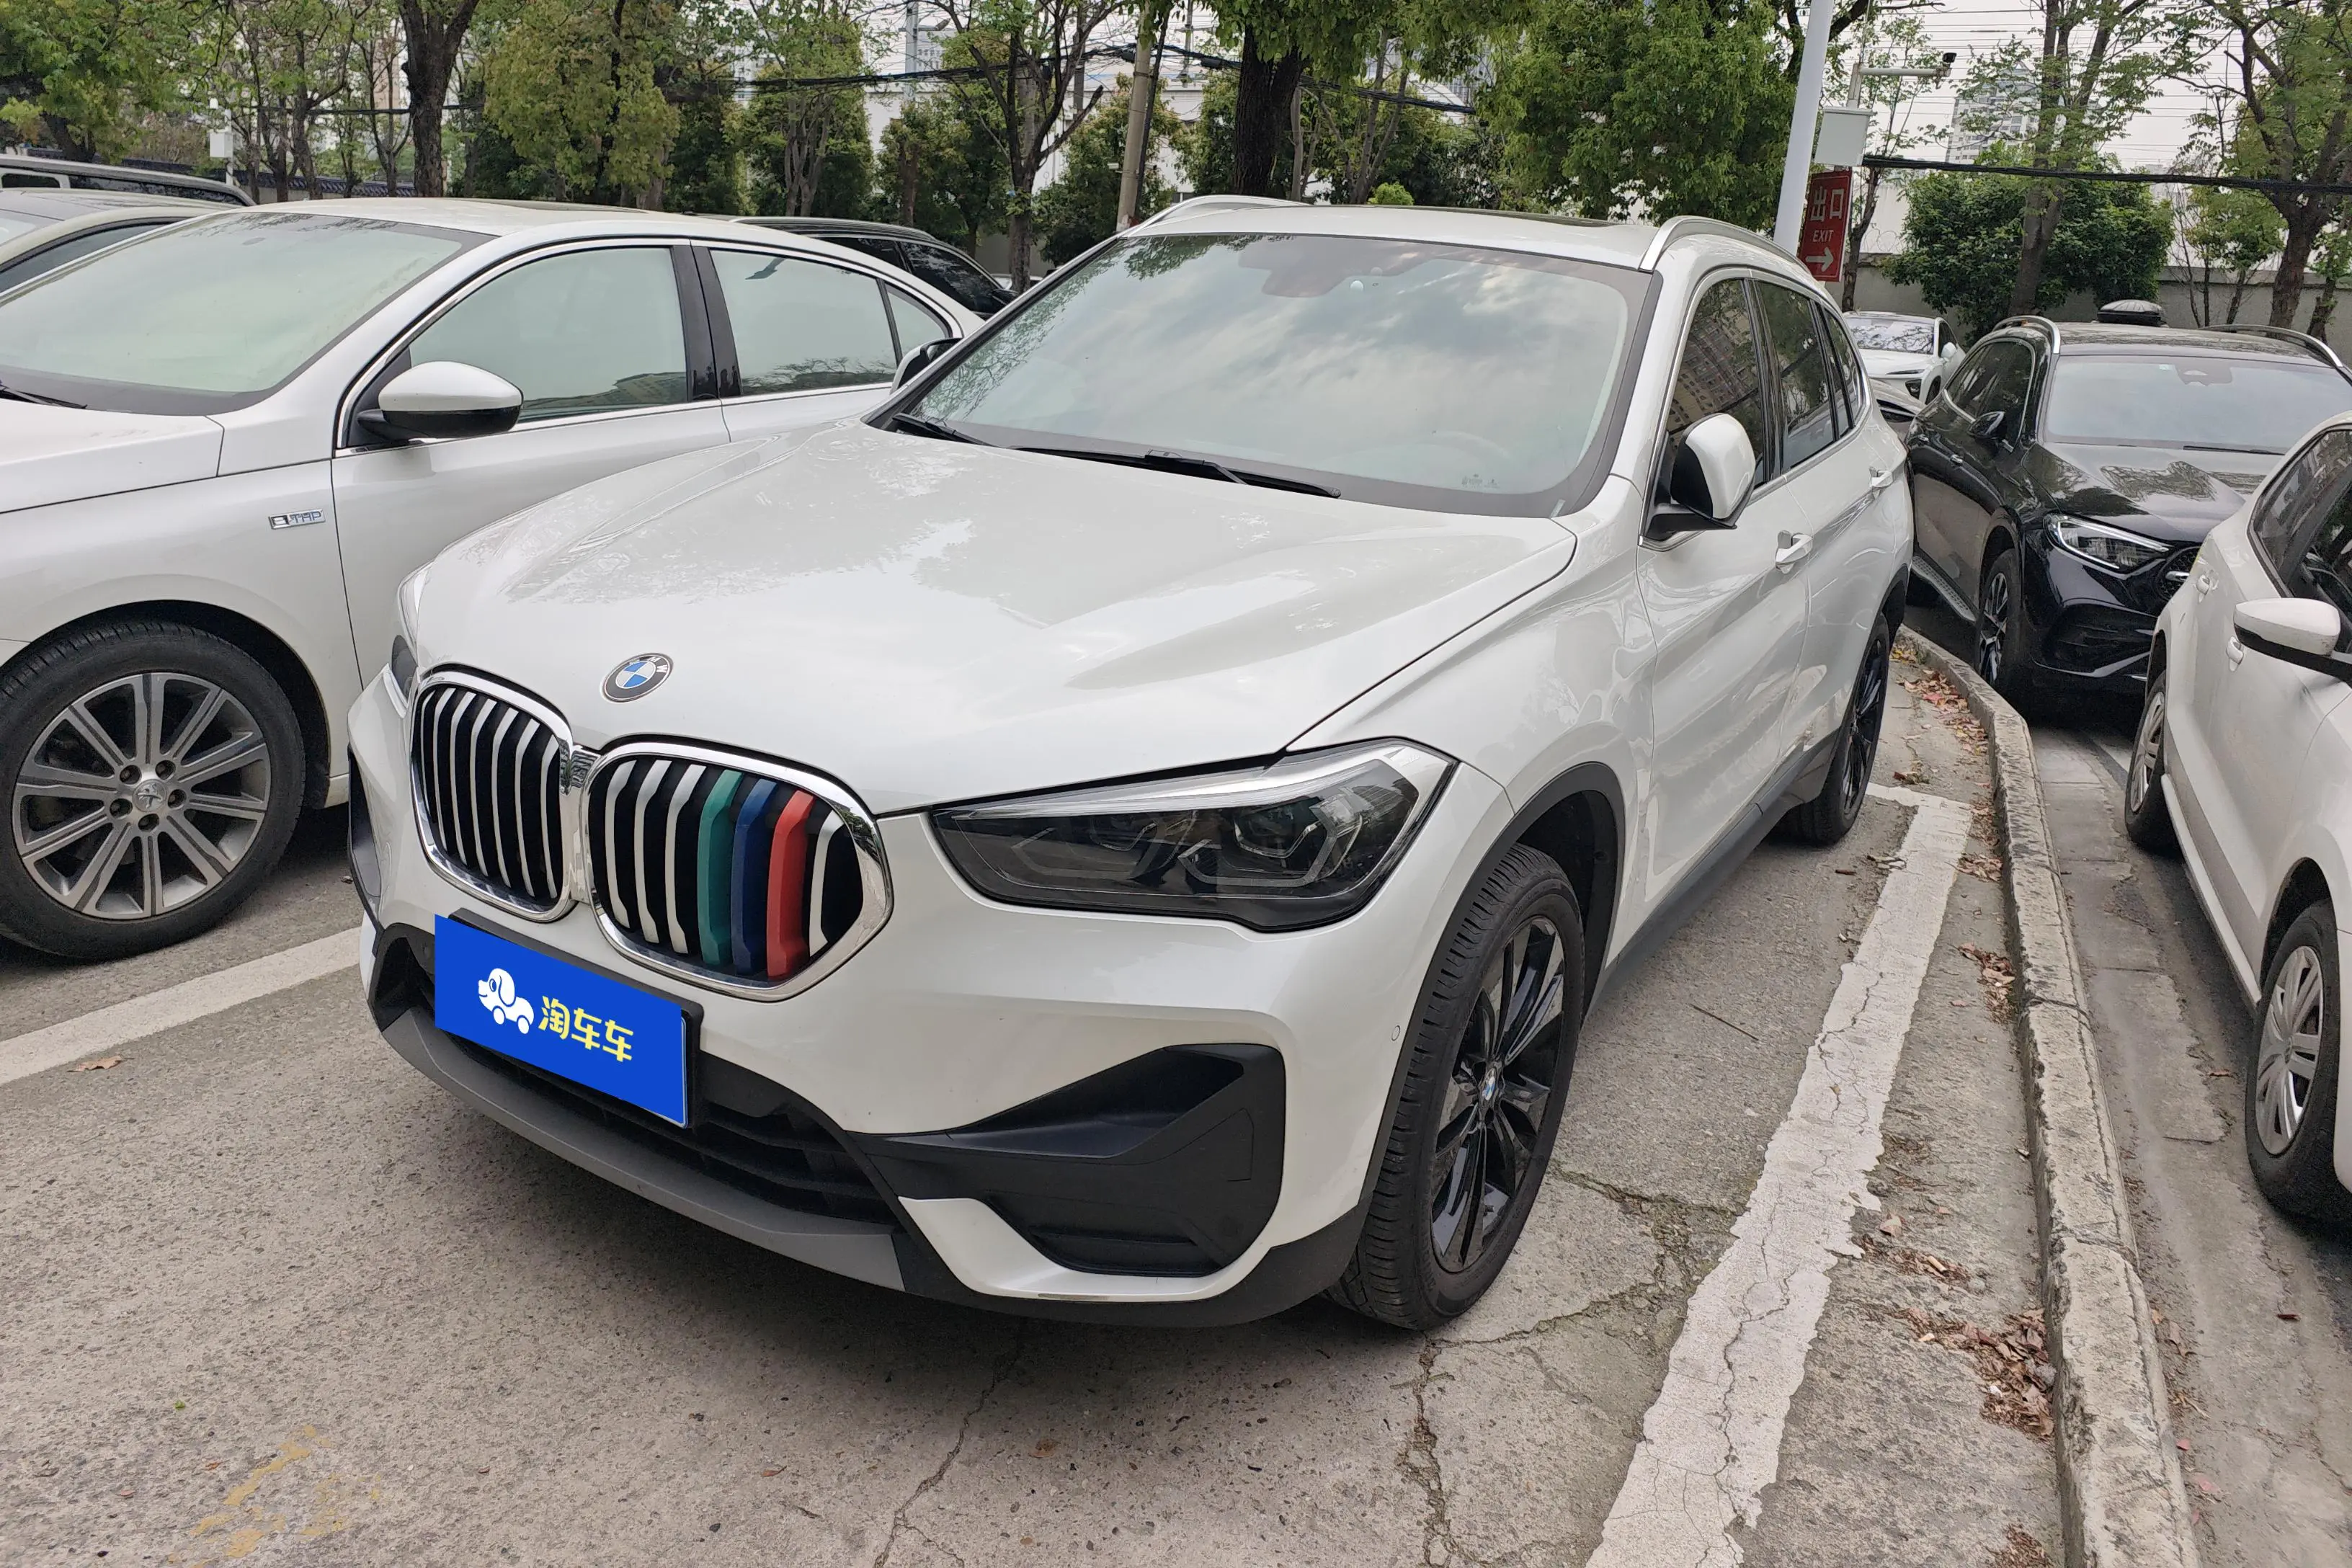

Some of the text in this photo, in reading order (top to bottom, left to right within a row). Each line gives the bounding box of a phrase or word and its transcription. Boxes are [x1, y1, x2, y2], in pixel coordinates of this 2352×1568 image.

[1810, 186, 1845, 222] 出口
[1812, 229, 1834, 242] EXIT
[291, 511, 321, 523] THP
